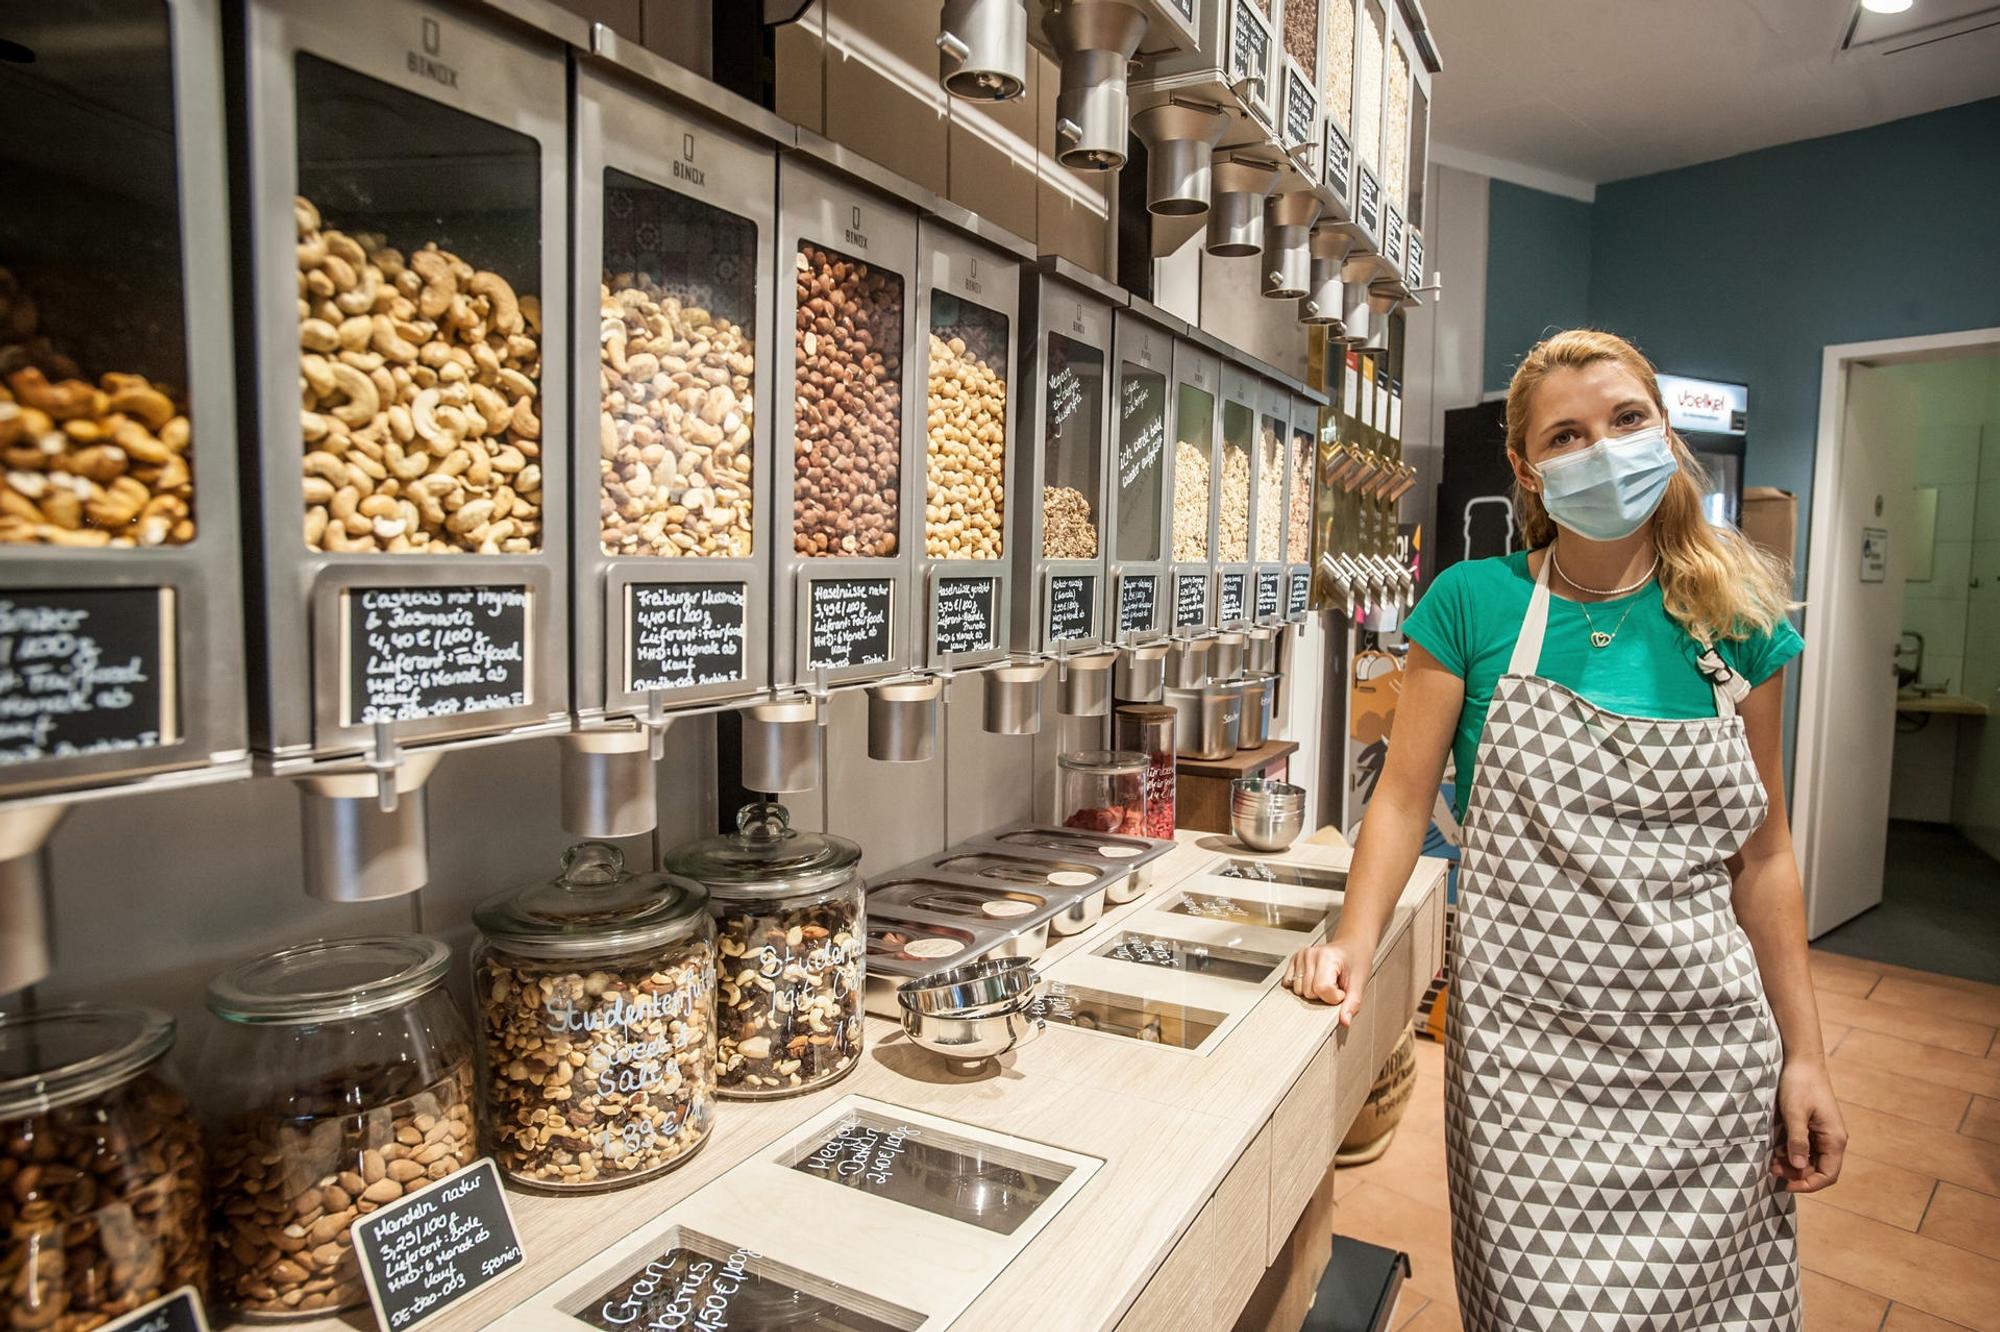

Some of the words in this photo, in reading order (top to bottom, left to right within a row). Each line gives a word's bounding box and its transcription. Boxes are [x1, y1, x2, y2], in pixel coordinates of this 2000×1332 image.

[407, 50, 458, 88] BINOX
[673, 160, 705, 186] BINOX
[845, 229, 869, 250] BINOX
[965, 277, 982, 294] BINOX
[637, 589, 700, 612] Freiburger
[814, 583, 867, 601] Haselnüsse
[388, 607, 475, 628] Rosmarin
[868, 625, 877, 637] ab
[721, 640, 737, 655] ab
[486, 665, 508, 682] ab
[374, 1200, 438, 1242] Mandeln
[441, 1175, 482, 1204] natur
[425, 1260, 434, 1273] 6
[436, 1237, 475, 1266] Monate
[475, 1227, 491, 1243] ab
[481, 1245, 522, 1277] Spanien
[423, 1262, 458, 1290] Kauf
[648, 1261, 714, 1331] berries
